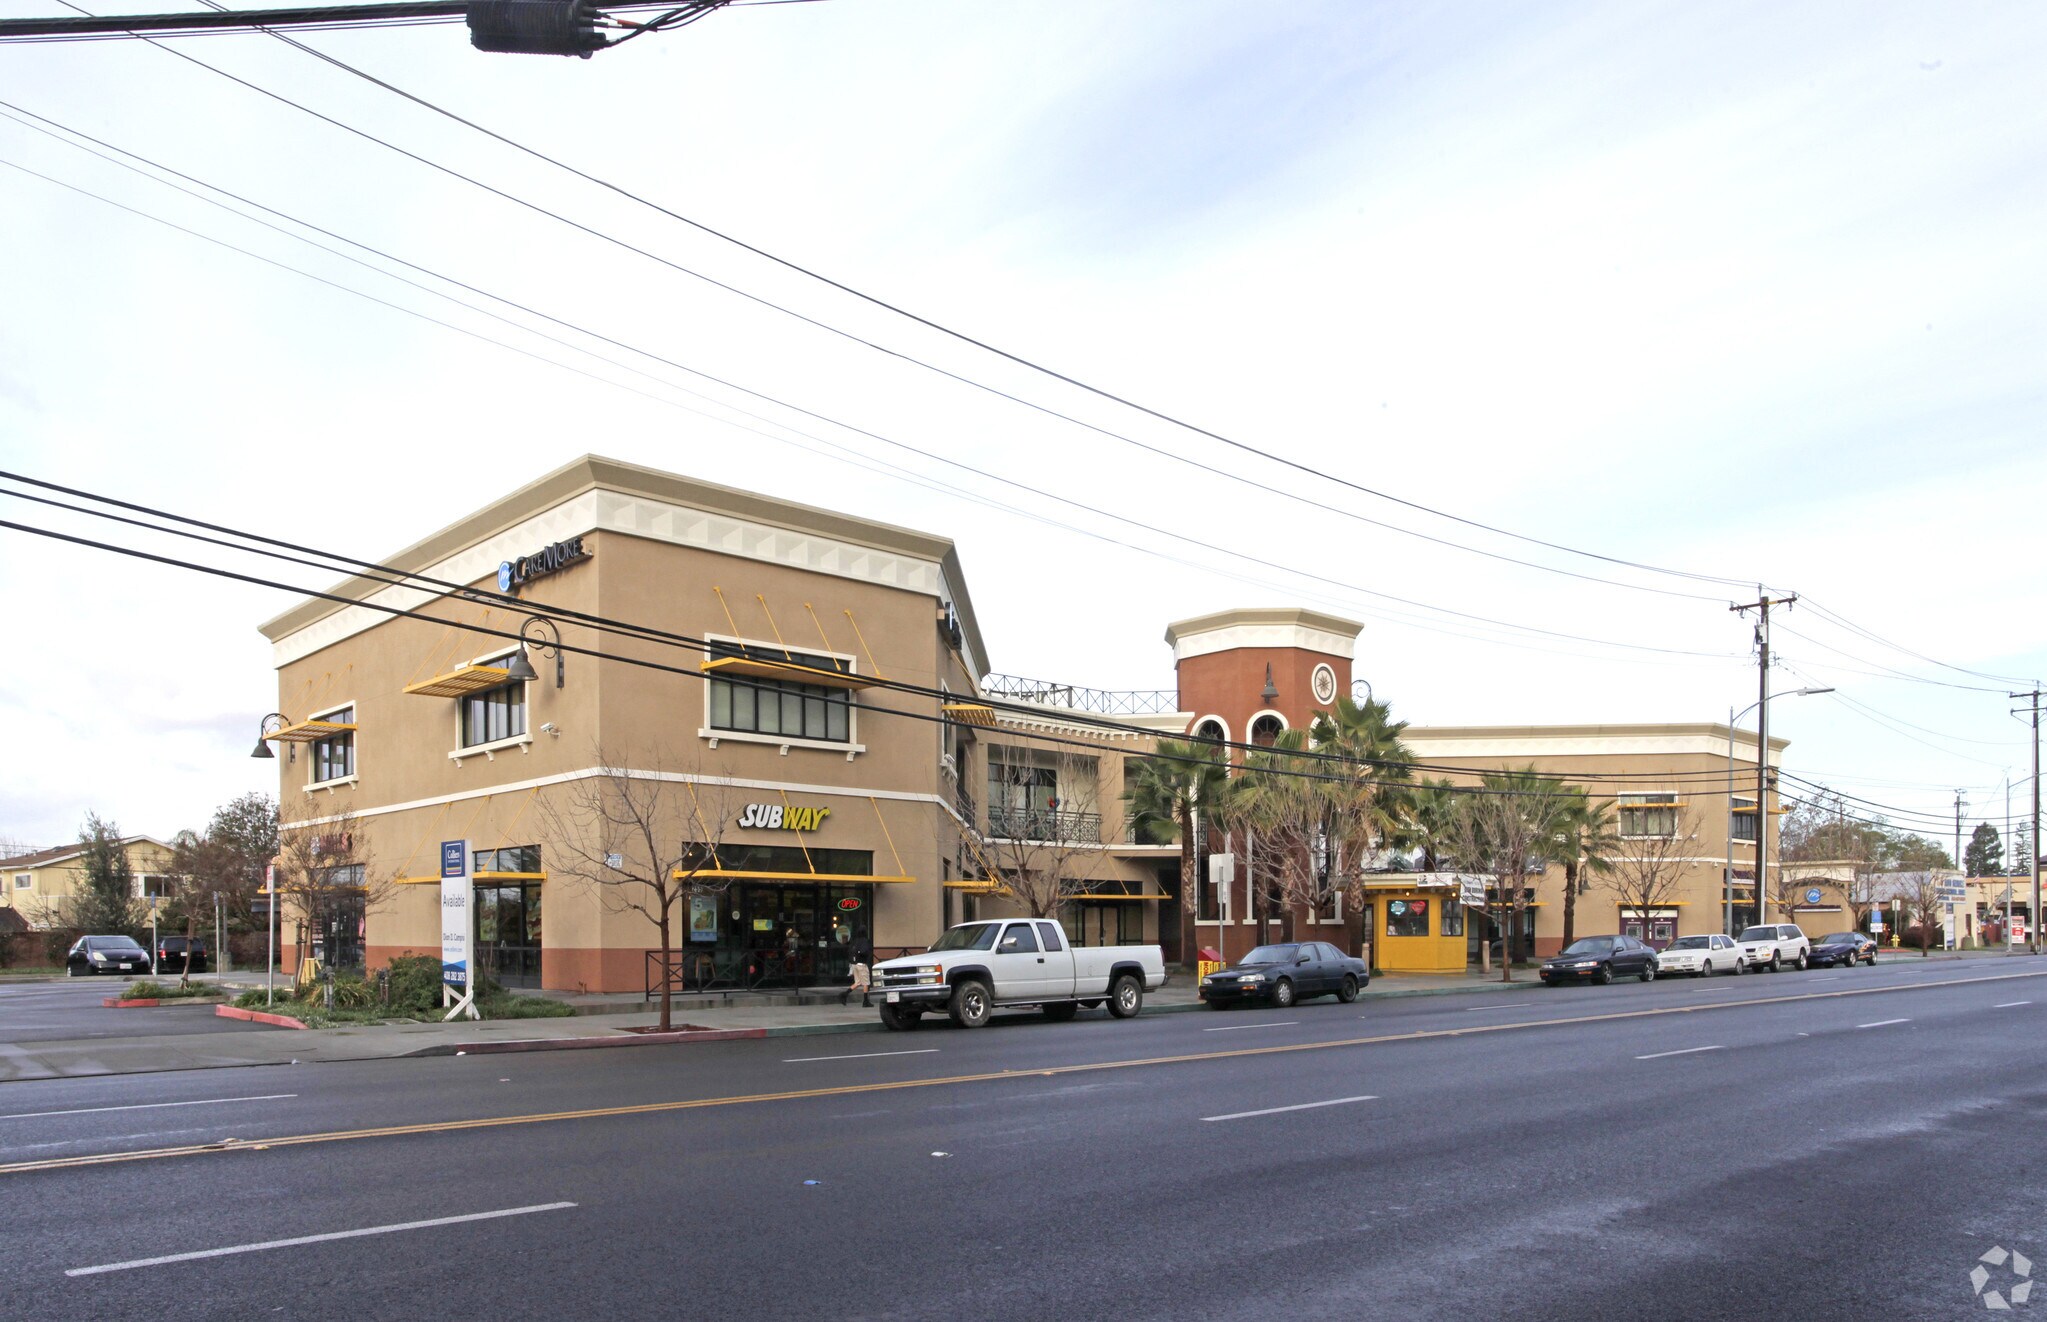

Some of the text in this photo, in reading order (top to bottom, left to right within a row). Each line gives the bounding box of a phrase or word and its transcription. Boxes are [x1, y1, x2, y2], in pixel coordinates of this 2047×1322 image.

[739, 803, 831, 831] SUBWAY
[443, 893, 465, 908] Available
[841, 899, 859, 909] OPEN
